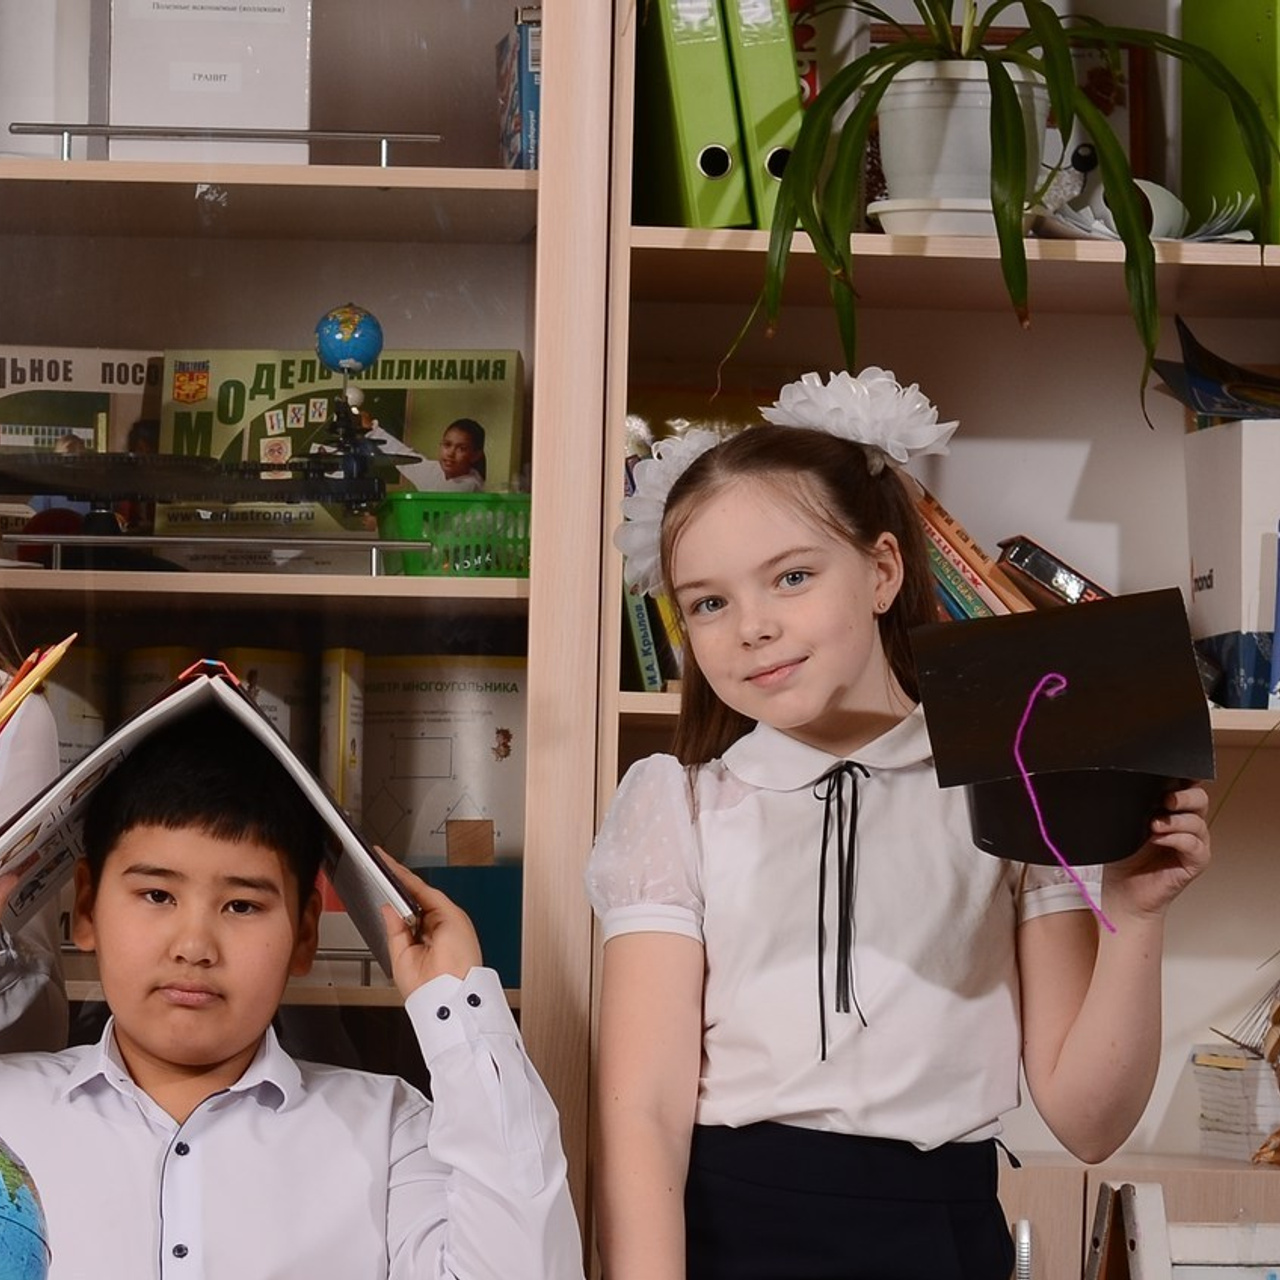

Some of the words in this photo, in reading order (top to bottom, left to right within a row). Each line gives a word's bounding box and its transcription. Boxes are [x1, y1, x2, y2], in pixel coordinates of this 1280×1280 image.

[192, 73, 228, 82] ГРАНИТ
[635, 603, 654, 657] Крылов
[402, 681, 519, 694] МНОГОУГОЛЬНИКА
